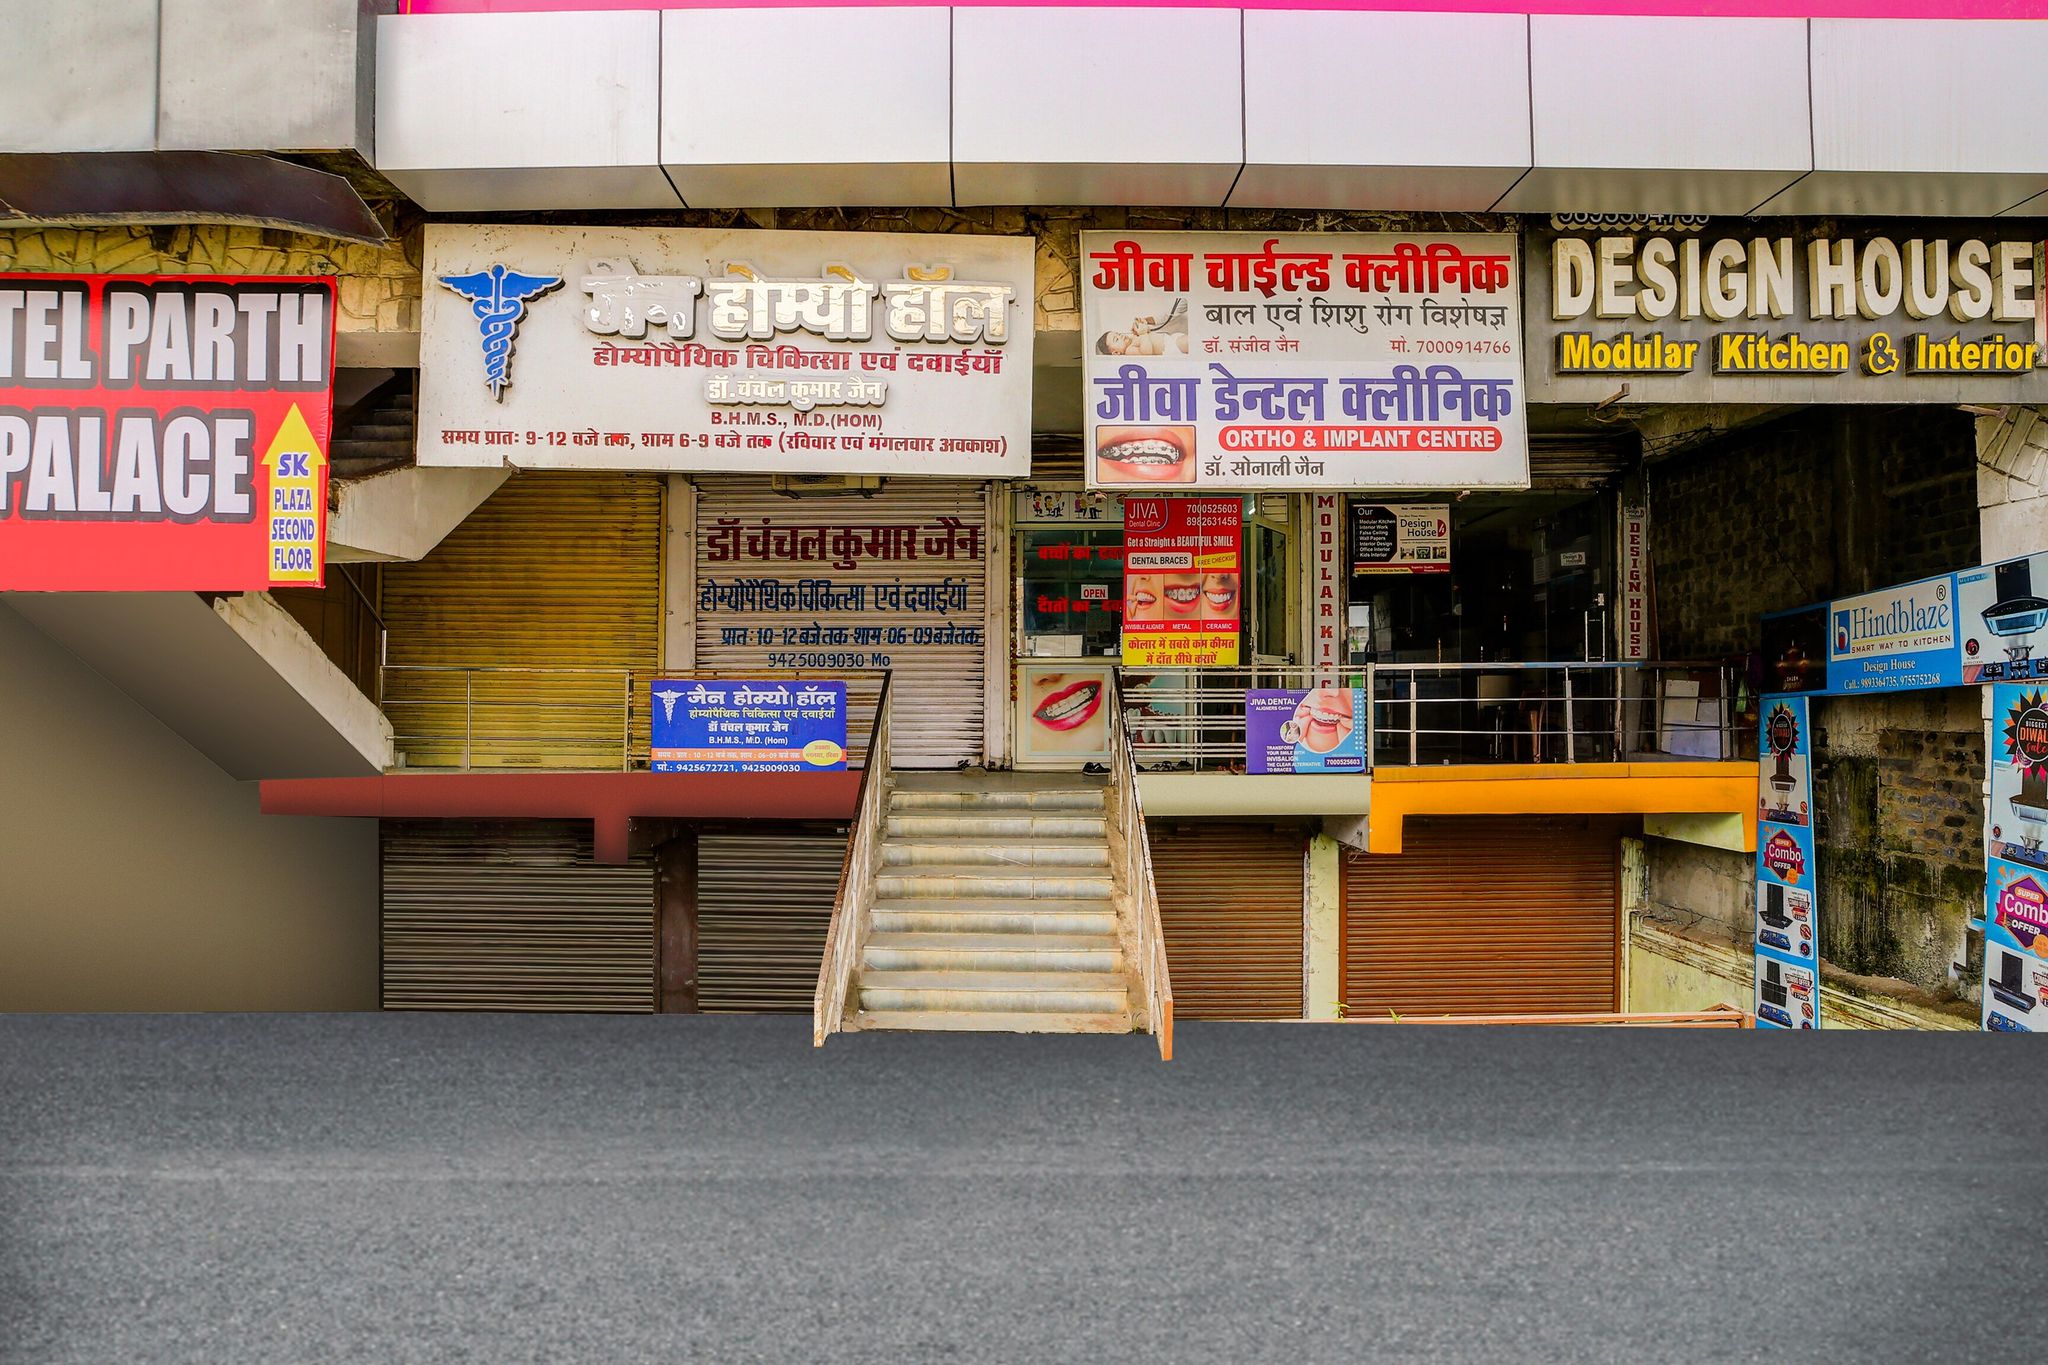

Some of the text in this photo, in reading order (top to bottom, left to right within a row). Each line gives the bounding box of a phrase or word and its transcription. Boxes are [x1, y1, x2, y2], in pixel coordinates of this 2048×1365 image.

[1090, 239, 1511, 299] जीवा चाईल्ड क्लीनिक
[1552, 237, 2036, 323] DESIGN HOUSE
[708, 264, 1012, 336] होम्यो हॉल
[1203, 296, 1508, 334] बाल एवं शिशु रोग विशेषज्ञ
[109, 291, 324, 381] PARTH
[1202, 335, 1300, 353] डॉ. संजीव जैन
[1390, 336, 1511, 354] मो. 7000914766
[593, 342, 738, 368] होम्योपैथिक
[746, 345, 852, 370] चिकित्सा
[859, 346, 900, 371] एवं
[1562, 332, 2038, 374] Modular Kitchen & Interior
[708, 375, 882, 405] डॉ. चंचल कुमार जैन
[1093, 363, 1513, 422] जीवा डेन्टल क्लीनिक
[710, 411, 883, 430] B.H.M.S., M.D.(HOM)
[441, 430, 480, 445] समय
[525, 431, 567, 446] 9-12
[641, 433, 674, 448] शाम
[679, 433, 709, 447] 6-9
[746, 434, 772, 449] तक
[778, 431, 837, 453] (रविवार
[841, 432, 865, 450] एवं
[868, 432, 934, 452] मंगलवार
[939, 436, 1007, 457] अवकाश)
[1225, 429, 1496, 448] ORTHO & IMPLANT CENTRE
[0, 415, 250, 515] PALACE
[278, 453, 309, 477] SK
[1204, 455, 1325, 476] डॉ. सोनाली जैन
[274, 488, 312, 511] PLAZA
[1129, 502, 1158, 519] JIVA
[1358, 507, 1374, 516] Our
[271, 518, 315, 541] SECOND
[1147, 520, 1160, 528] Clinic
[1400, 518, 1433, 531] Design
[1408, 529, 1437, 537] House
[747, 518, 830, 560] चंचल
[831, 524, 919, 570] कुमार
[923, 517, 981, 560] जैन
[1127, 538, 1138, 547] Get
[1144, 537, 1170, 548] Straight
[1213, 536, 1233, 546] SMILE
[274, 547, 312, 570] FLOOR
[1131, 556, 1188, 565] DENTAL BRACES
[1317, 495, 1334, 617] MODULAR
[872, 577, 902, 611] एवं
[1083, 588, 1106, 598] OPEN
[1629, 522, 1641, 657] DESIGN HOUSE
[1851, 597, 1949, 640] Hindblaze
[1128, 637, 1156, 649] कोलार
[1158, 636, 1168, 648] में
[1169, 637, 1190, 649] सबसे
[1210, 636, 1235, 648] कीमत
[1851, 635, 1951, 654] SMART WAY TO KITCHEN
[1863, 659, 1916, 674] Design House
[687, 684, 837, 706] जैन होम्यो हॉल
[1250, 698, 1297, 706] JIVA DENTAL
[742, 707, 780, 719] चिकित्सा
[784, 708, 798, 720] एवं
[720, 721, 743, 732] चंचल
[745, 722, 770, 735] कुमार
[772, 721, 789, 732] जैन
[708, 736, 744, 746] B.H.M.S.,
[764, 736, 789, 747] (Hom)
[742, 764, 800, 773] 9425009030
[1769, 844, 1802, 862] Combo
[1773, 861, 1792, 870] OFFER
[2017, 888, 2040, 901] SUPER
[2011, 919, 2041, 936] OFFER
